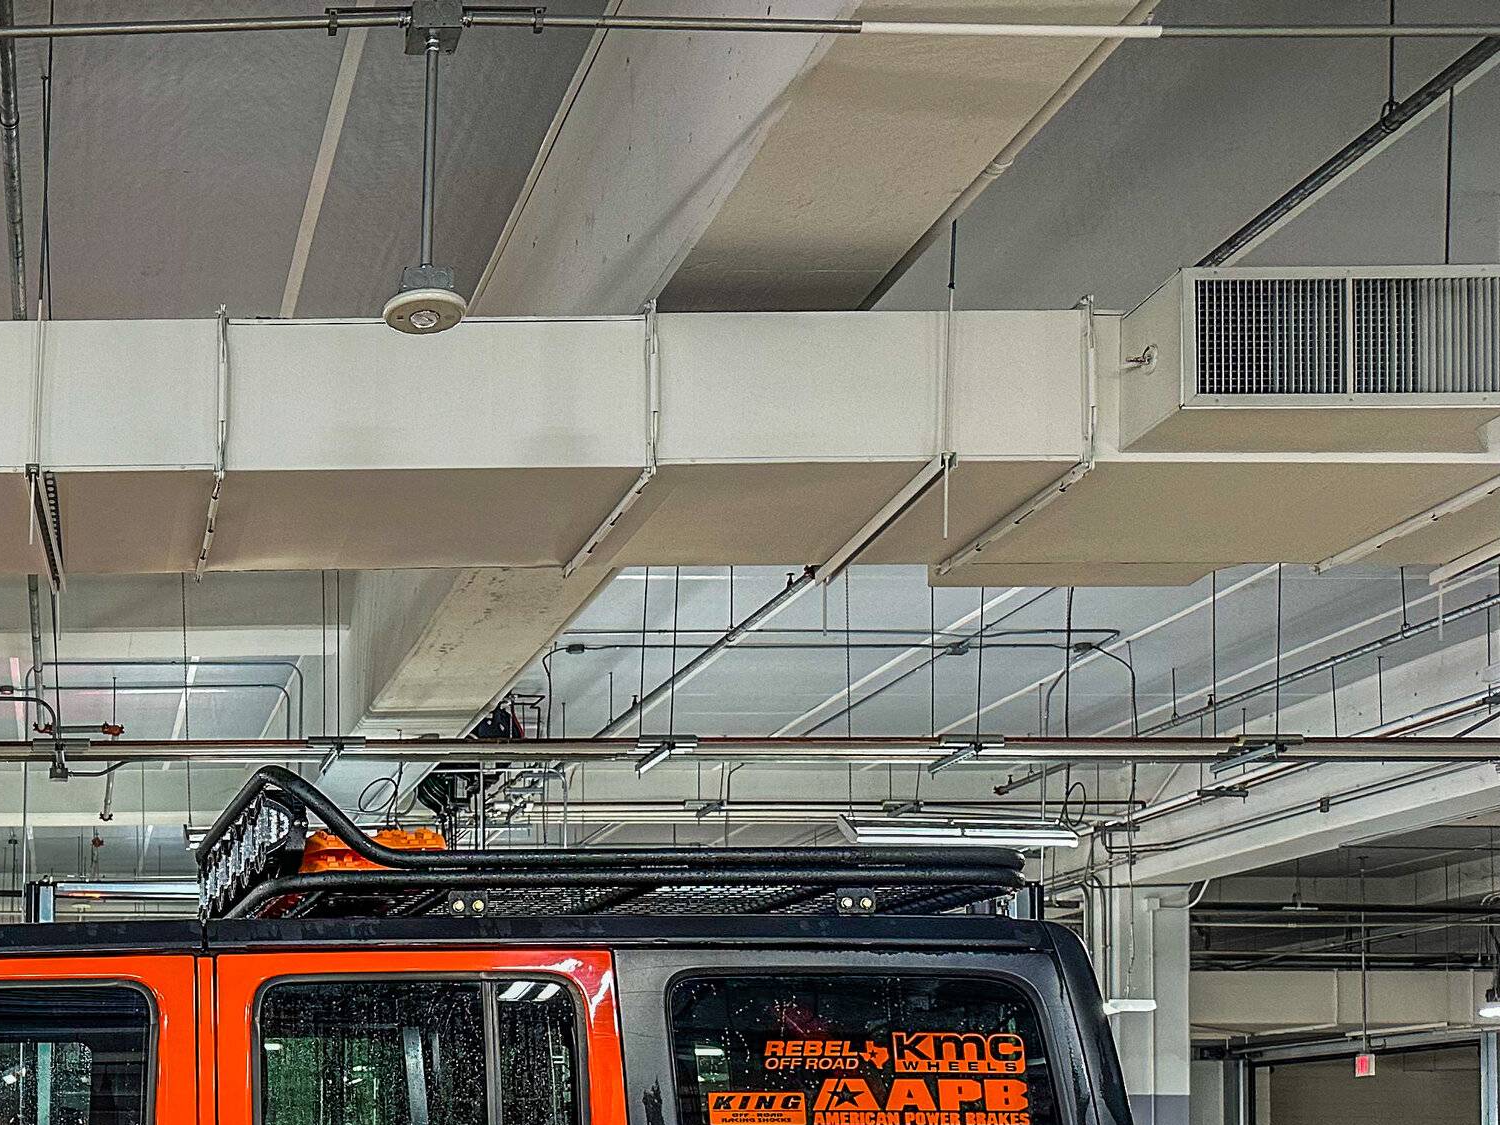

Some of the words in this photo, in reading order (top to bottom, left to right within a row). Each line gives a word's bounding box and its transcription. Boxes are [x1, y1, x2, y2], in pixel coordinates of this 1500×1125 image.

[764, 1040, 858, 1057] REBEL
[765, 1057, 802, 1070] OFF
[805, 1057, 859, 1070] ROAD
[902, 1060, 1018, 1072] WHEELS
[712, 1095, 802, 1110] KING
